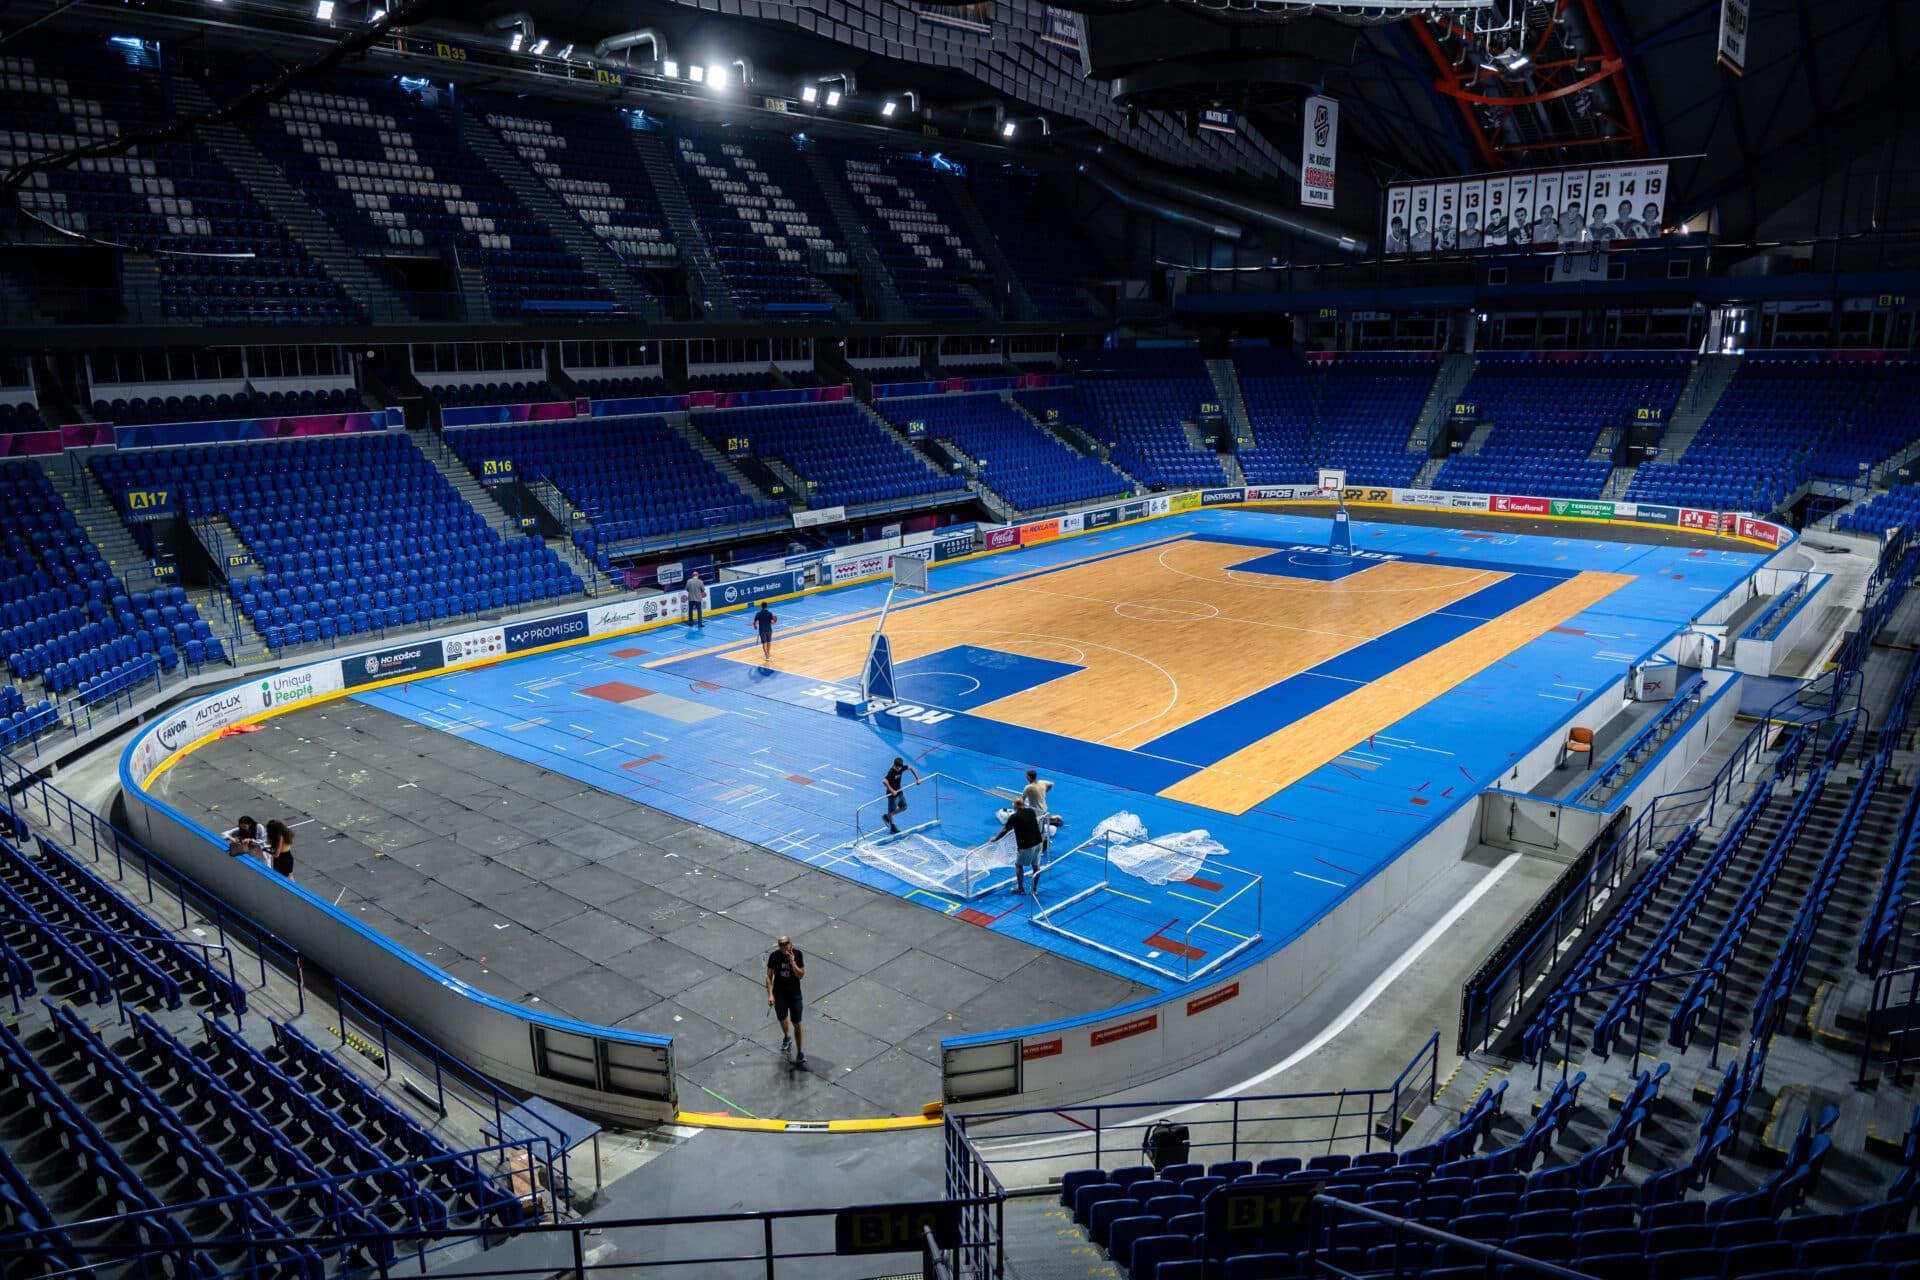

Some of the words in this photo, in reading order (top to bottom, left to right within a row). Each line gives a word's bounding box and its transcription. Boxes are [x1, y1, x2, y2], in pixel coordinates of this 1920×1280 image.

[1546, 185, 1552, 201] 1
[1567, 183, 1582, 199] 15
[1594, 182, 1610, 198] 21
[1619, 180, 1635, 196] 14
[1645, 178, 1661, 195] 19
[1443, 195, 1452, 210] 5
[1465, 193, 1479, 208] 13
[1493, 191, 1502, 205] 9
[1518, 188, 1527, 203] 7
[1393, 199, 1405, 214] 17
[1418, 197, 1427, 212] 9
[1455, 404, 1475, 415] A11
[1637, 408, 1661, 419] A11
[727, 438, 749, 451] A15
[483, 460, 512, 475] A16
[129, 491, 168, 510] A17
[1260, 489, 1292, 499] TIPOS
[1510, 503, 1543, 512] Kaufland
[1570, 503, 1612, 511] TERMOSTAV
[229, 556, 248, 566] A17
[530, 620, 584, 641] PROMISEO
[381, 656, 393, 664] HC
[393, 650, 422, 662] KOŠICE
[273, 671, 312, 692] Unique
[275, 684, 313, 704] People
[195, 694, 241, 721] AUTOLUX
[163, 719, 187, 741] FAVOR
[1227, 1195, 1308, 1232] B17
